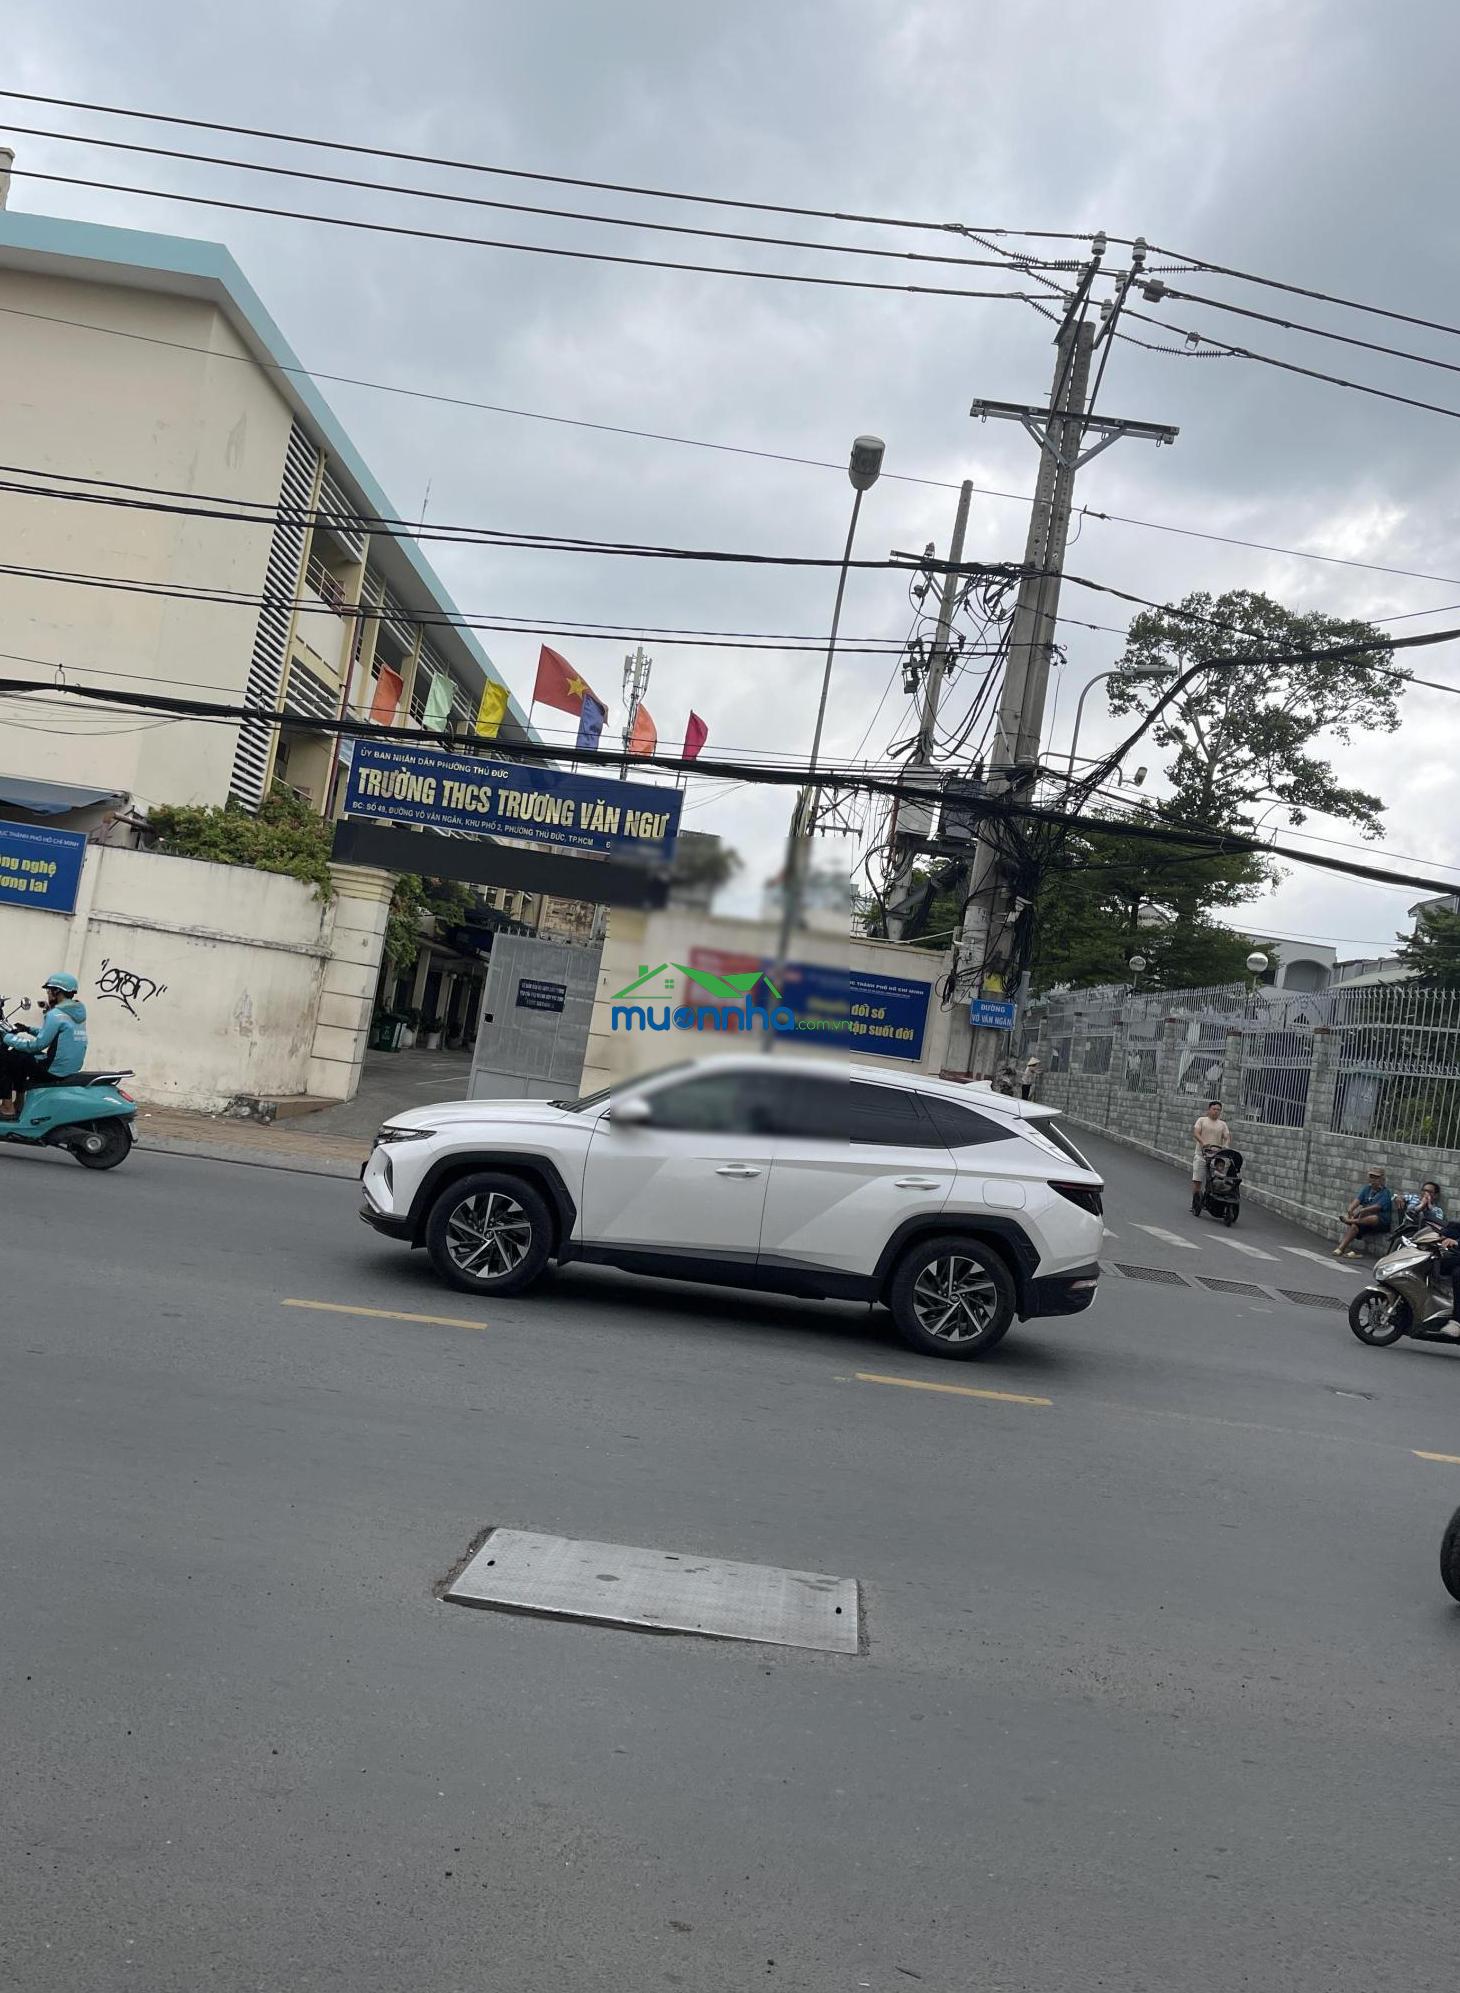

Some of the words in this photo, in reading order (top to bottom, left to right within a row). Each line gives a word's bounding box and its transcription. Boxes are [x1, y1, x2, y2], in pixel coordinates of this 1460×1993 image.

[360, 747, 373, 757] ỦY
[374, 751, 391, 761] BAN
[393, 753, 416, 764] NHÂN
[418, 757, 435, 767] DÂN
[436, 760, 471, 773] PHƯỜNG
[473, 765, 490, 776] THỦ
[491, 767, 509, 779] ĐỨC
[357, 766, 437, 805] TRƯỜNG
[441, 779, 492, 814] THCS
[496, 788, 575, 827] TRƯƠNG
[580, 798, 621, 835] VĂN
[623, 809, 670, 839] NGƯ
[366, 802, 376, 811] SỐ
[388, 805, 414, 817] ĐƯỜNG
[415, 810, 425, 819] VÕ
[426, 811, 441, 821] VĂN
[465, 817, 481, 827] KHU
[481, 818, 496, 830] PHỐ
[504, 824, 534, 836] PHƯỜNG
[535, 828, 549, 839] THỦ
[569, 835, 594, 846] TP.HCM
[0, 854, 20, 871] ng
[21, 859, 57, 878] nghệ
[0, 875, 28, 891] ơng
[29, 878, 49, 893] lai
[871, 1007, 887, 1020] số
[980, 1003, 1006, 1013] ĐƯỜNG
[868, 1024, 894, 1038] suốt
